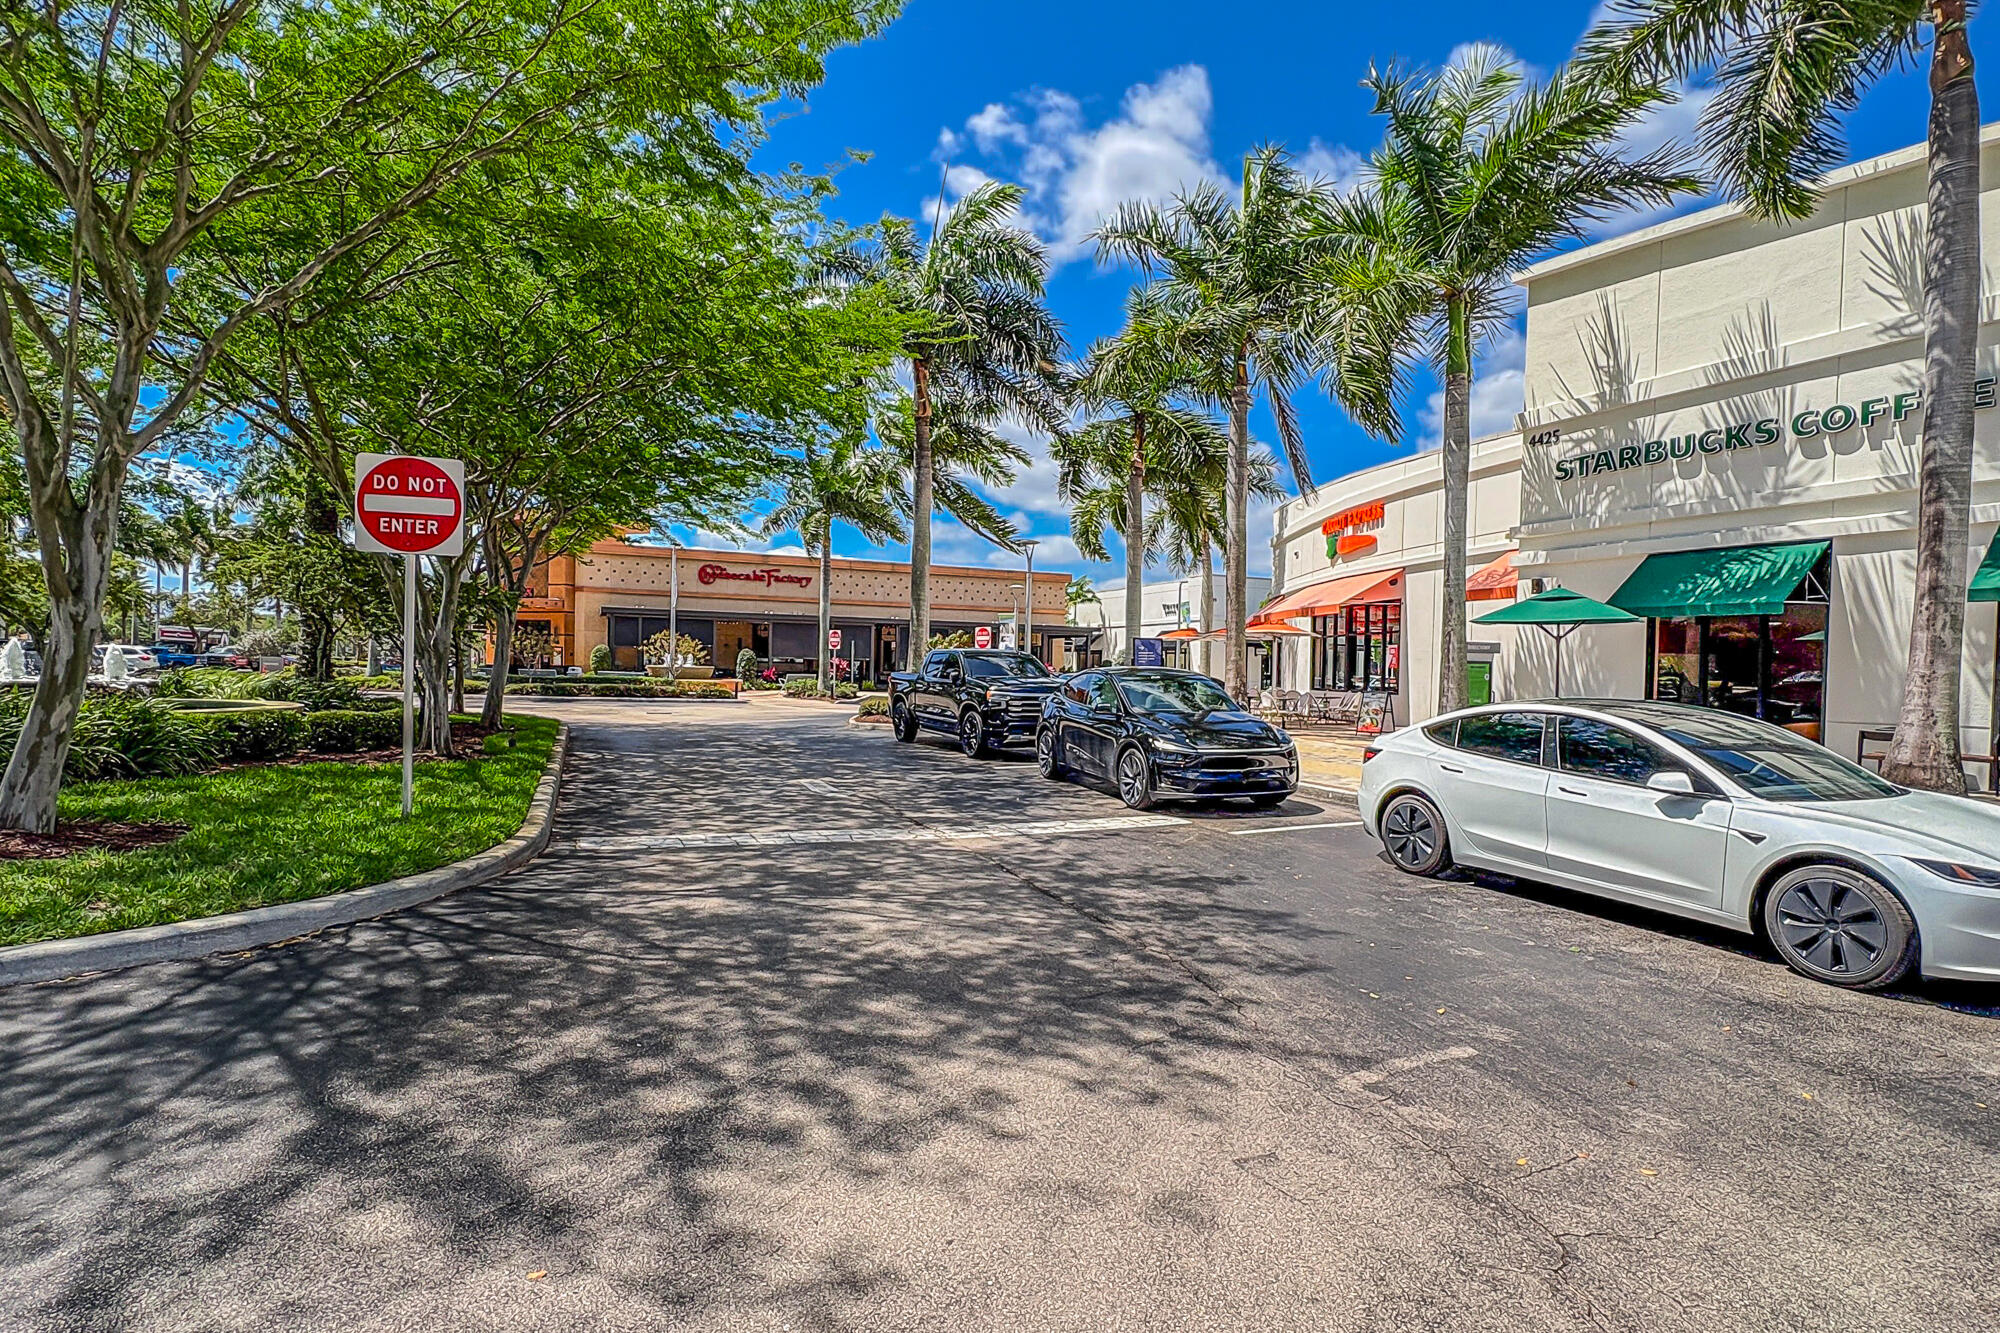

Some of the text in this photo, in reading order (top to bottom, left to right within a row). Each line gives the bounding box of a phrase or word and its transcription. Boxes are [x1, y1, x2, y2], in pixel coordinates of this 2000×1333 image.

[1529, 429, 1560, 447] 4425
[1555, 376, 1997, 481] STARBUCKS COFFE
[373, 474, 447, 493] DO NOT
[379, 517, 438, 535] ENTER
[760, 568, 812, 588] Factory
